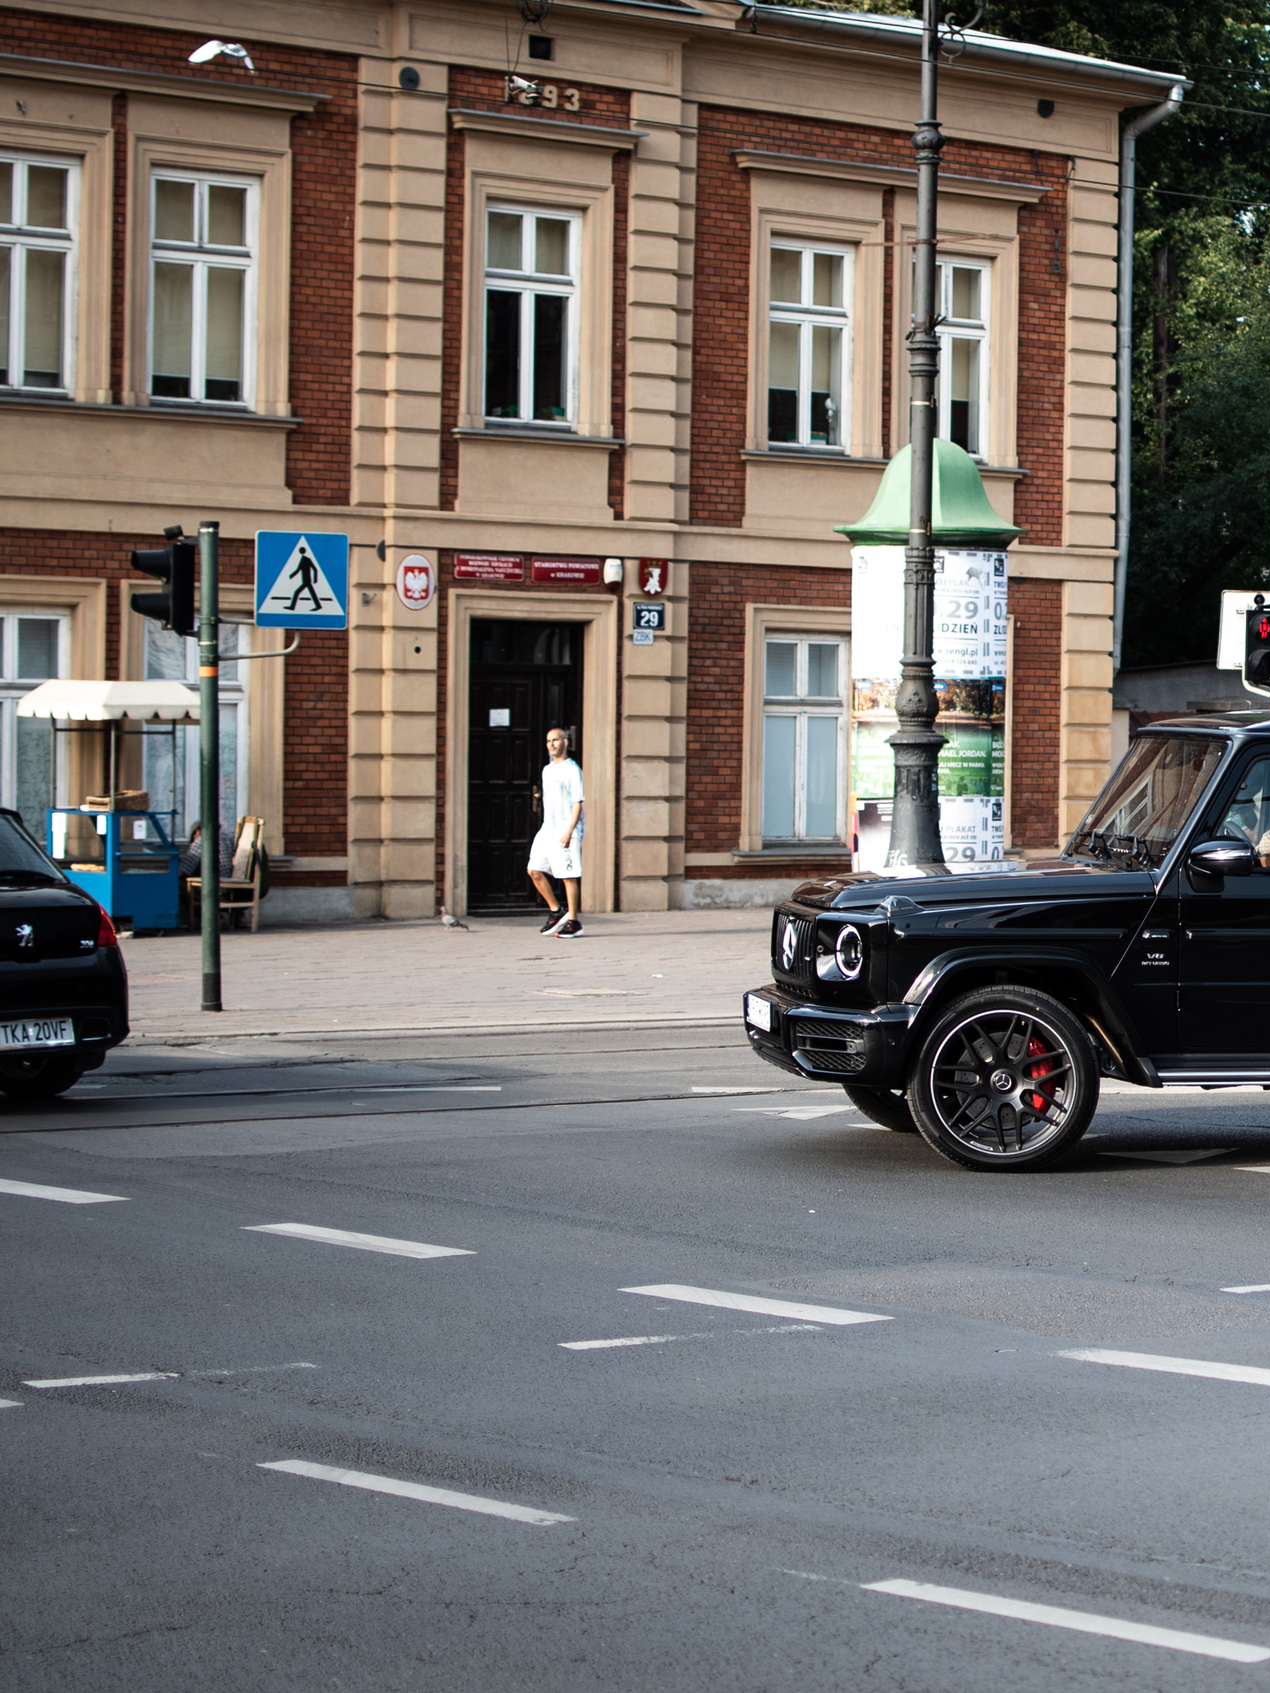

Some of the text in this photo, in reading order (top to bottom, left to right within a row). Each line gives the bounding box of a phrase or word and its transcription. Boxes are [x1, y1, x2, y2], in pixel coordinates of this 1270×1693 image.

[504, 77, 580, 111] 193
[935, 600, 980, 620] ,29
[640, 611, 659, 627] 29
[937, 622, 978, 634] /DZIEŃ
[936, 647, 978, 657] w.rengl.pl
[958, 749, 987, 758] JORDAN.
[1, 1020, 67, 1043] TKA 20VF
